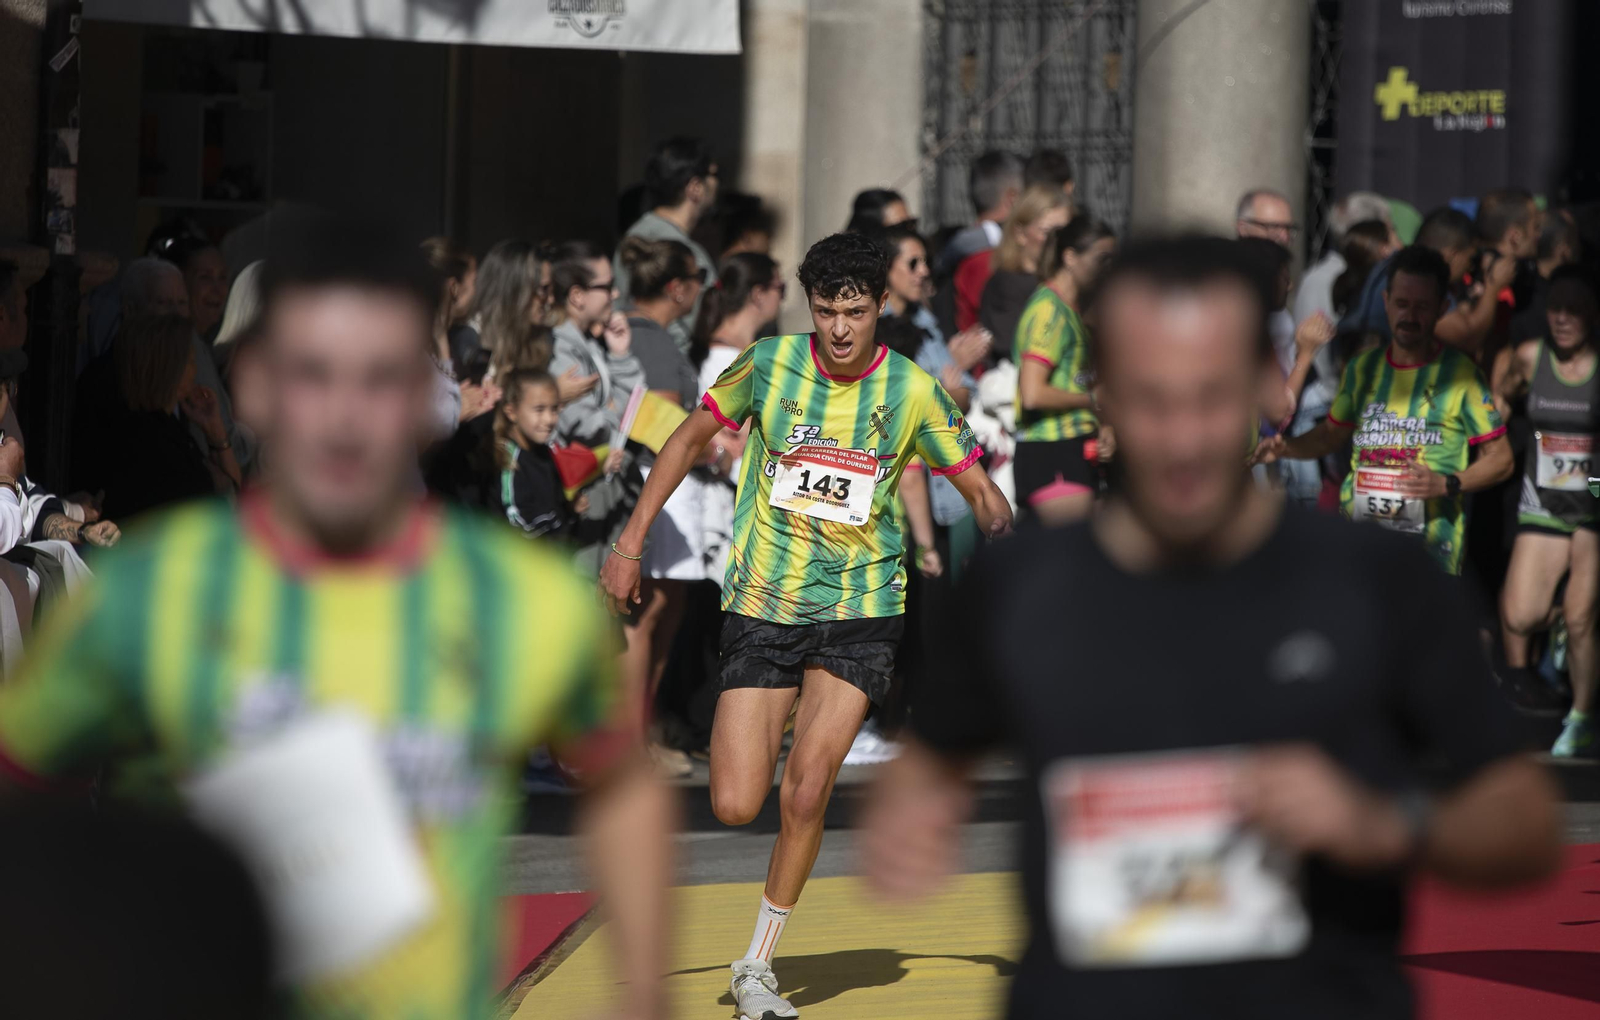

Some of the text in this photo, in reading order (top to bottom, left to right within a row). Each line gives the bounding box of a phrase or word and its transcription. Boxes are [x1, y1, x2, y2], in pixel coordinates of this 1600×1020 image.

[780, 398, 798, 408] RUN
[784, 406, 803, 417] PRO
[785, 424, 821, 444] 3ª
[1404, 431, 1443, 445] CIVIL
[807, 437, 838, 447] EDICIÓN
[811, 448, 838, 456] CARRERA
[850, 454, 868, 462] PILAR
[821, 455, 836, 463] CIVIL
[846, 460, 874, 471] OURENSE
[1553, 457, 1592, 475] 970
[797, 469, 852, 501] 143
[1368, 496, 1405, 516] 537
